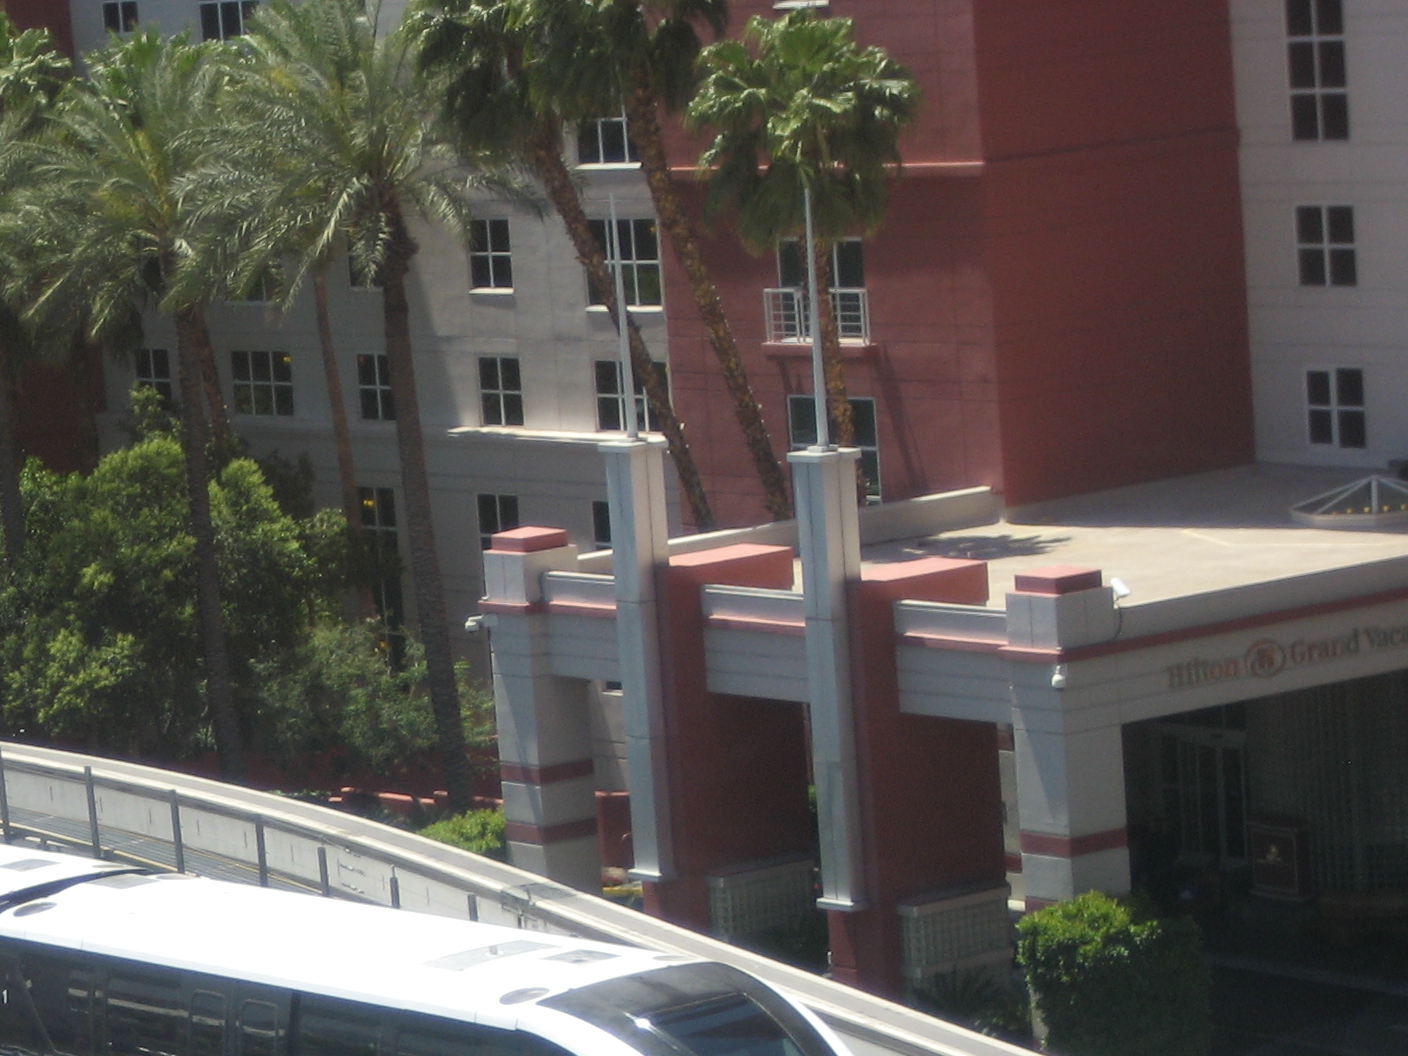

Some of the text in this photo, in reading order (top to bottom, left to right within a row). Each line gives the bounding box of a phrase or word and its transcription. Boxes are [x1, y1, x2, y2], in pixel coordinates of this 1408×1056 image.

[1166, 657, 1240, 688] Hilton
[1290, 627, 1360, 663] Grand
[2, 989, 8, 1004] 1
